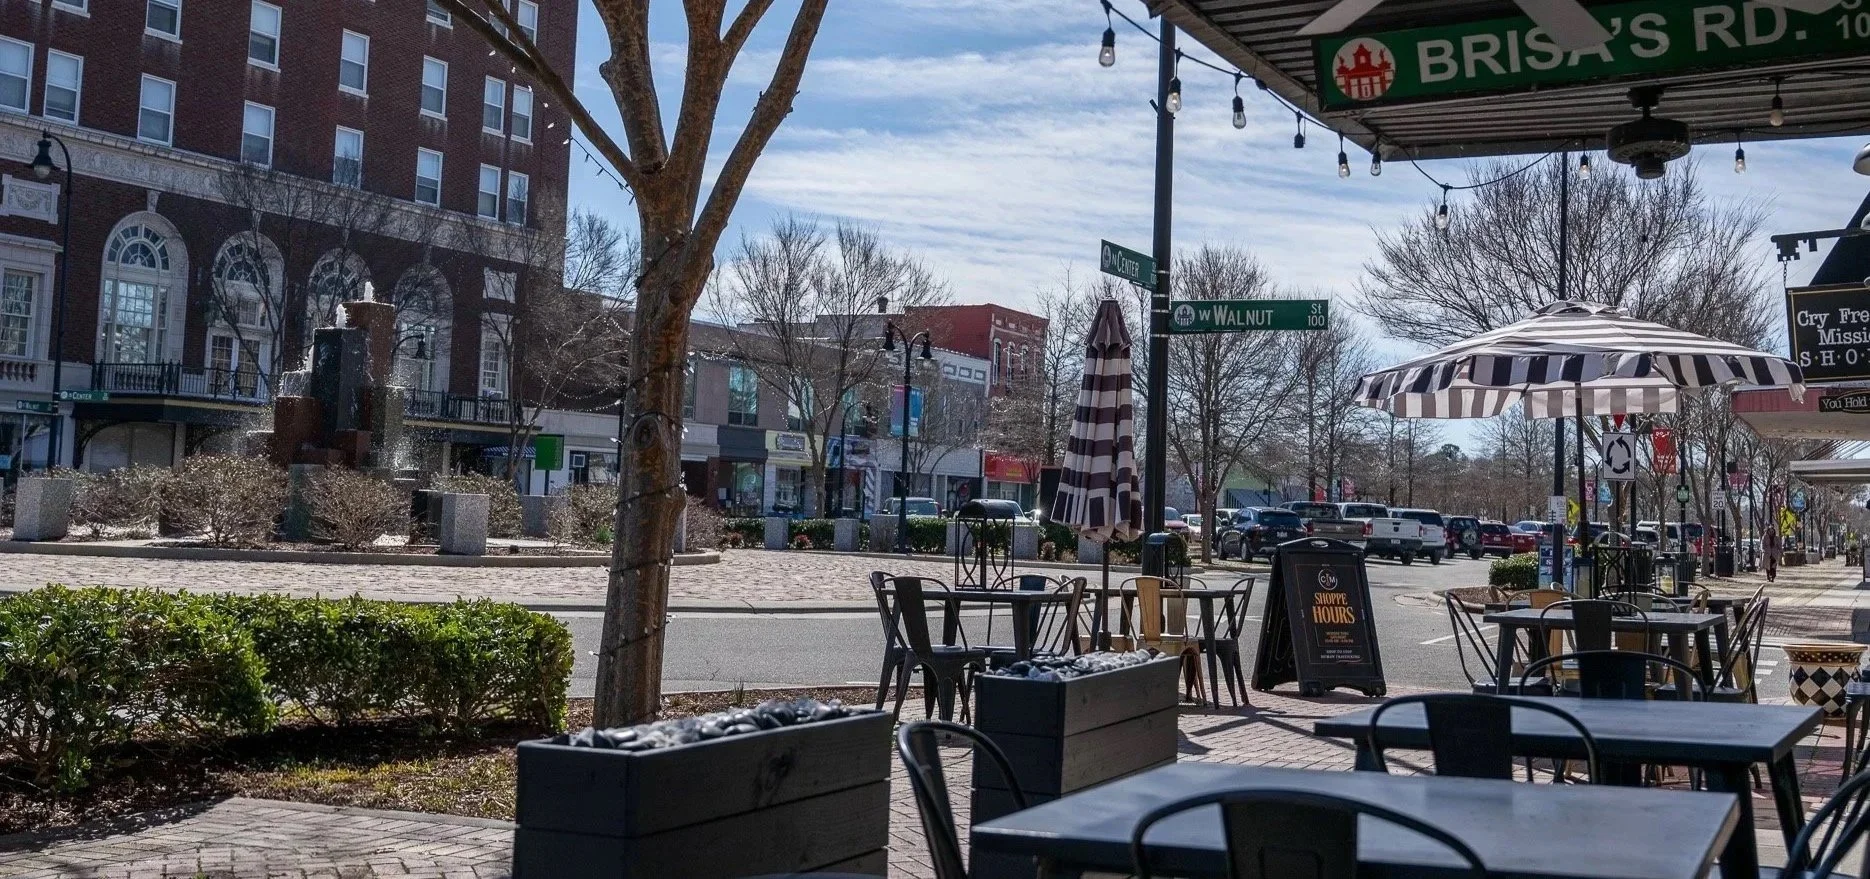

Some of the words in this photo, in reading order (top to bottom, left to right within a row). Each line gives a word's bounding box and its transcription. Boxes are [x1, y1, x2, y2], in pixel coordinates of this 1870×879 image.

[1693, 2, 1807, 52] RD.
[1117, 250, 1140, 278] CENTER
[1199, 309, 1212, 321] W
[1213, 304, 1274, 326] WALNUT
[1311, 303, 1322, 314] St
[1307, 315, 1325, 327] 100
[1797, 310, 1830, 329] Cry
[73, 391, 92, 400] CENTER
[1821, 398, 1843, 410] You
[1845, 396, 1867, 408] Hold
[1713, 500, 1723, 508] 20
[1314, 592, 1348, 606] SHOPPE
[1312, 606, 1355, 624] HOURS
